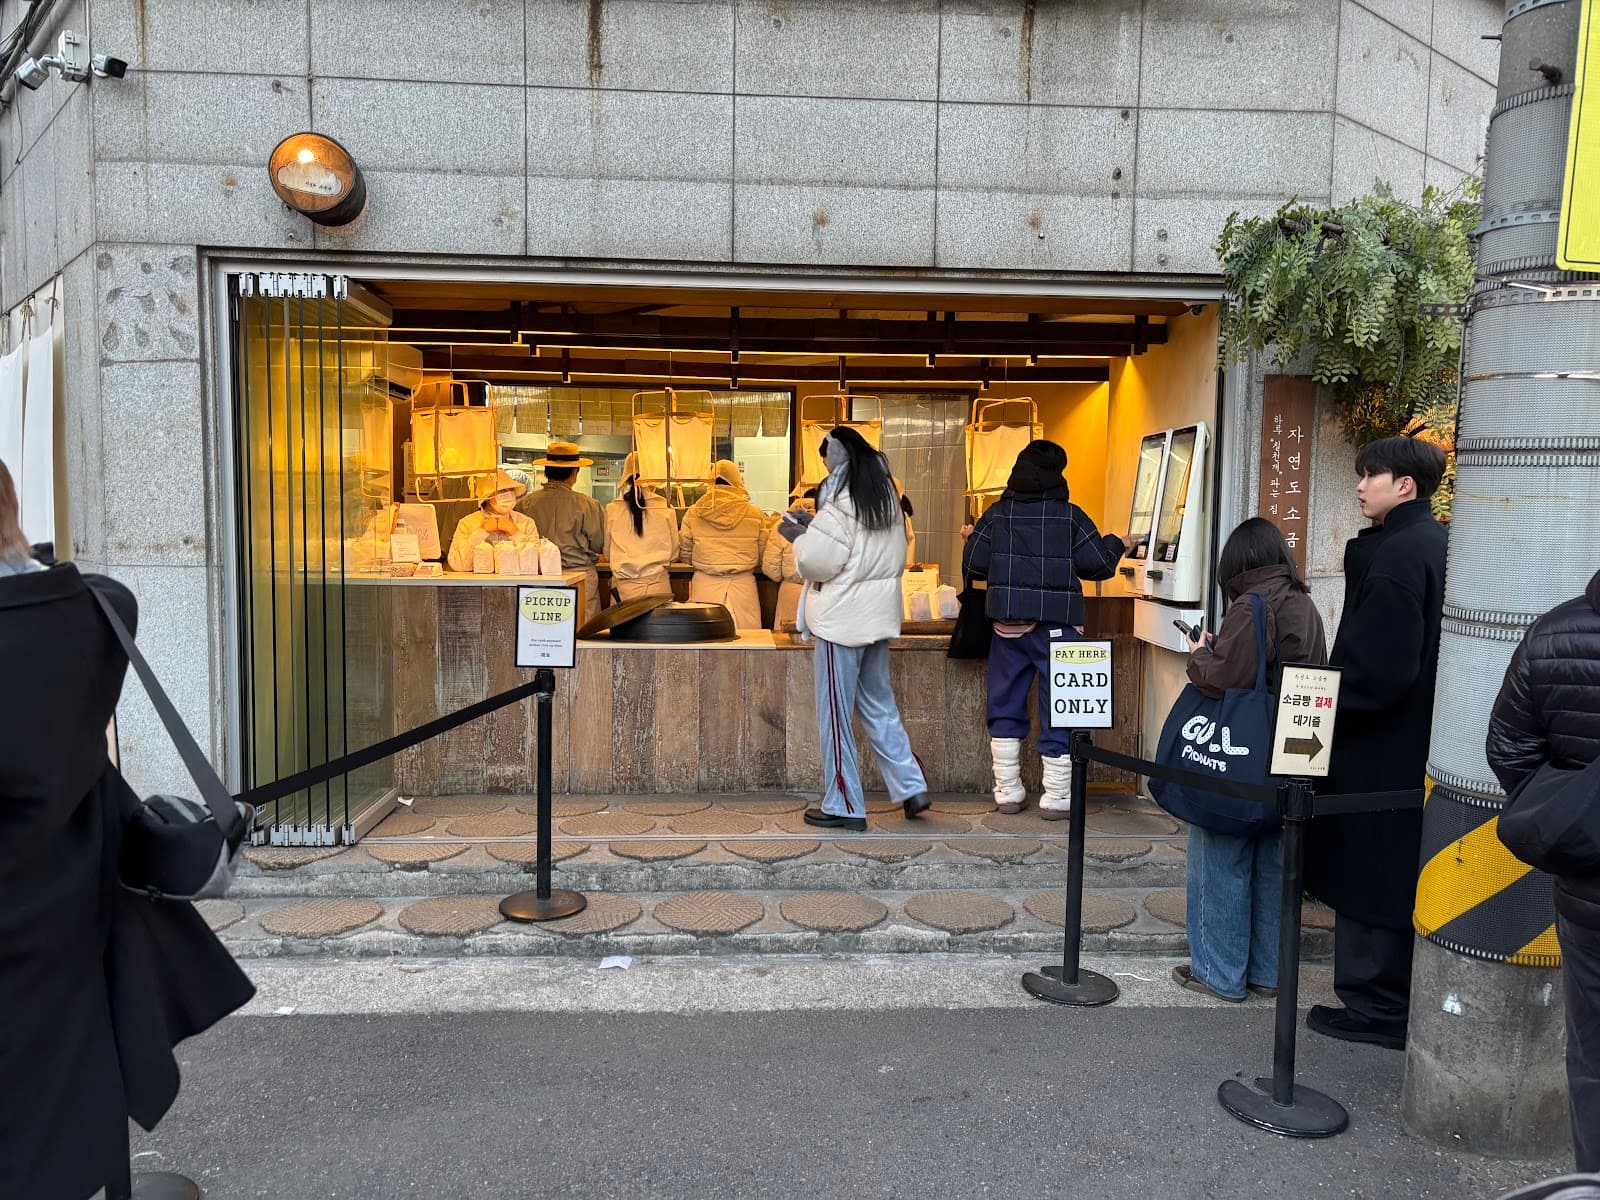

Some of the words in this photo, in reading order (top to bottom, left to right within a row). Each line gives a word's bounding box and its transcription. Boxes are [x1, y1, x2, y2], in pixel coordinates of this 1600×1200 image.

[1272, 413, 1283, 434] 하루
[1269, 477, 1281, 498] 파는
[1268, 503, 1278, 515] 집
[525, 596, 571, 607] PICKUP
[532, 612, 562, 621] LINE
[1055, 650, 1076, 659] PAY
[1079, 650, 1107, 659] HERE
[1054, 672, 1108, 688] CARD
[1054, 698, 1109, 714] ONLY
[1282, 693, 1312, 707] 소금빵
[1315, 695, 1333, 709] 결제
[1292, 714, 1321, 728] 대기줄
